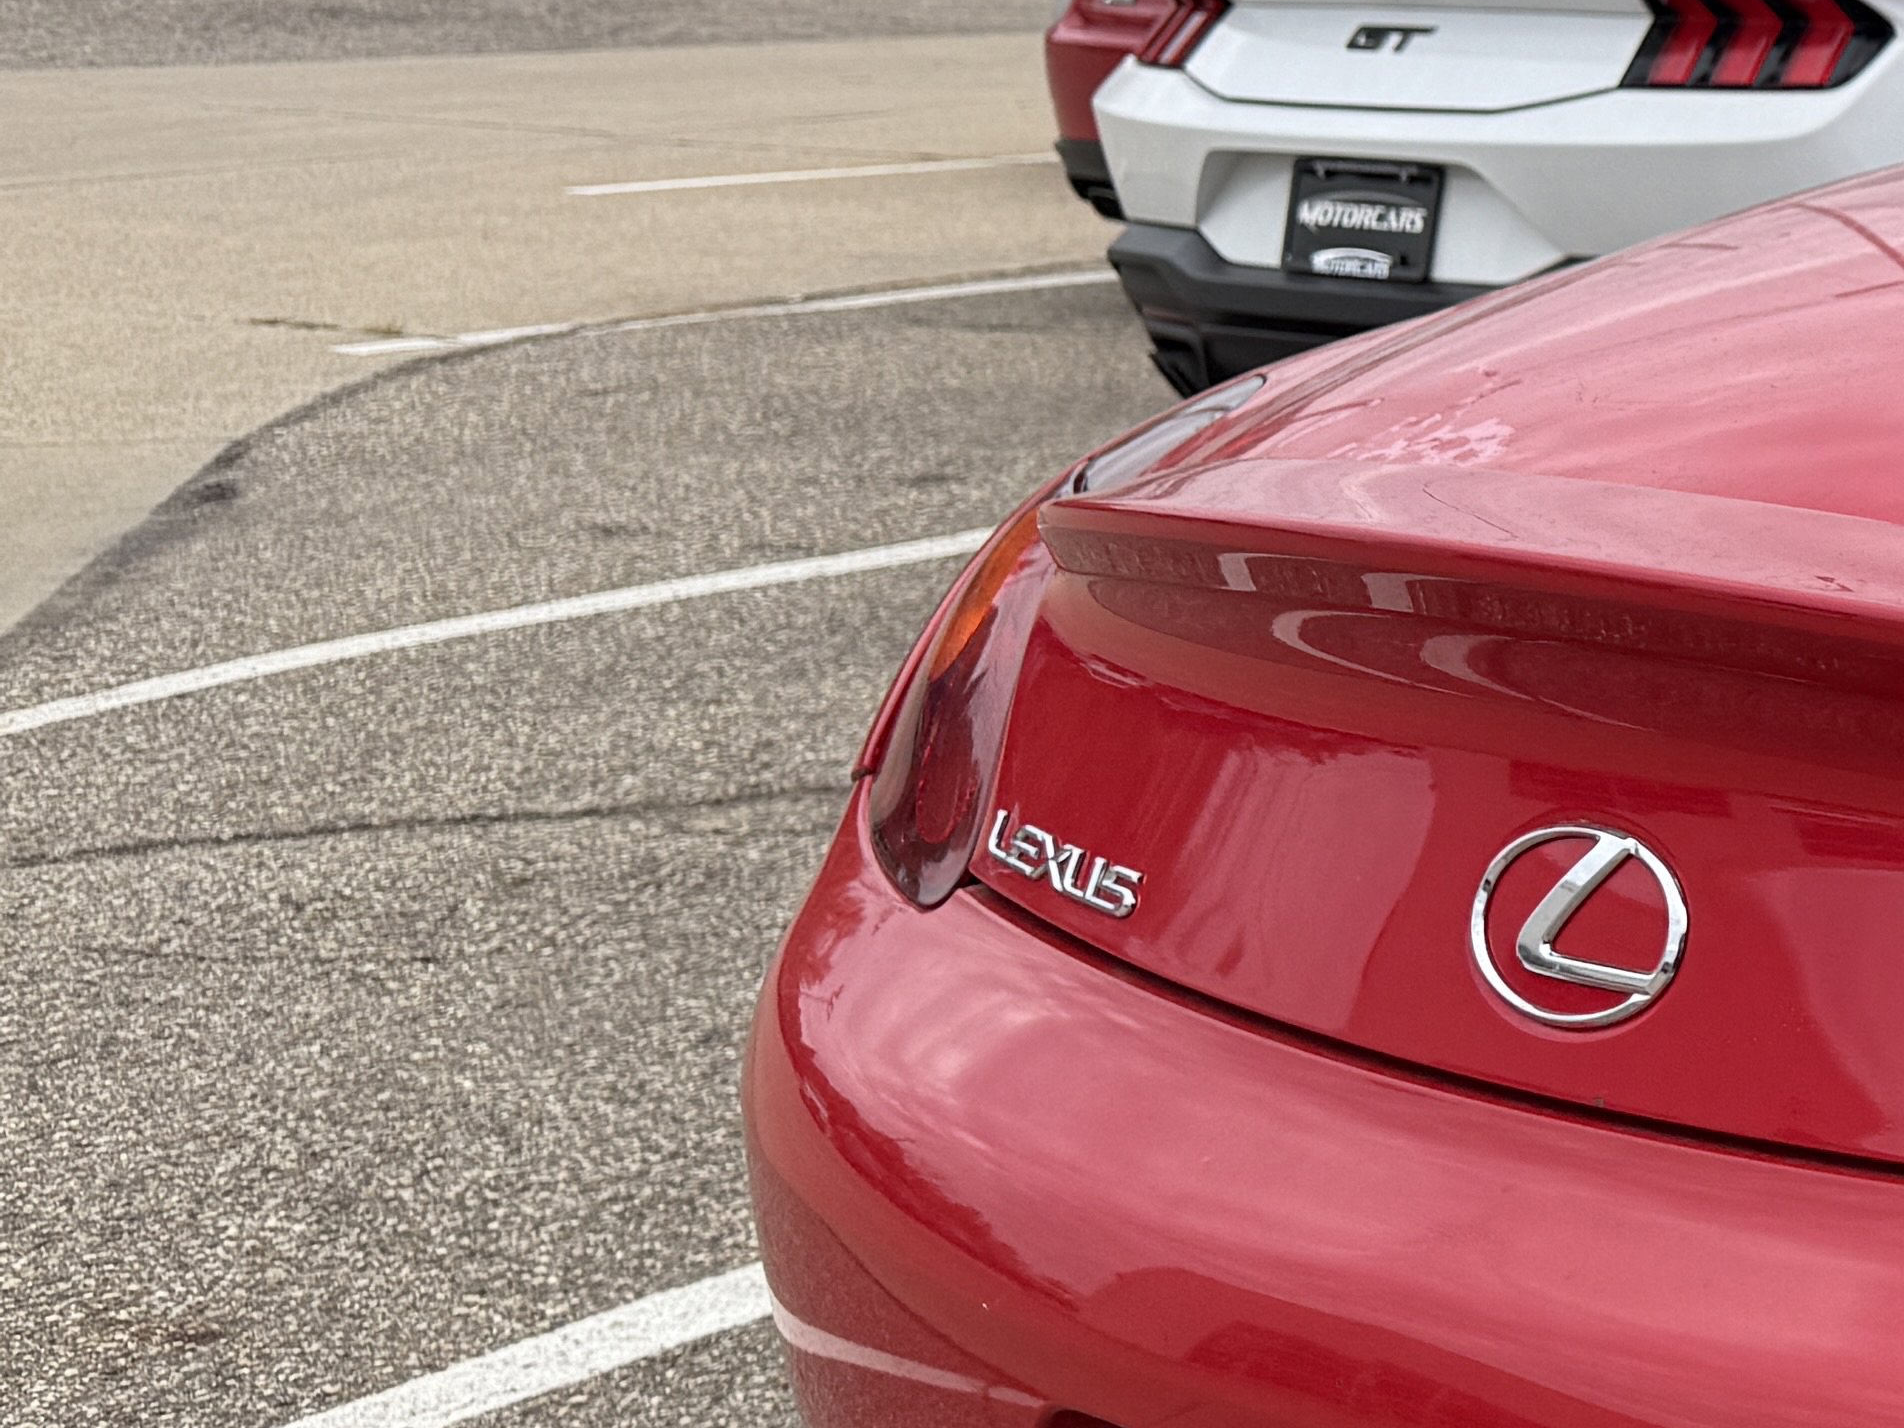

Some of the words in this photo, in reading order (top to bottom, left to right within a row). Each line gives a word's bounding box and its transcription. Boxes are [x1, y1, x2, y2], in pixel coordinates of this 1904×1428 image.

[1346, 26, 1438, 52] GT
[1298, 200, 1427, 234] MOTORCARS
[988, 809, 1143, 918] LEXUS
